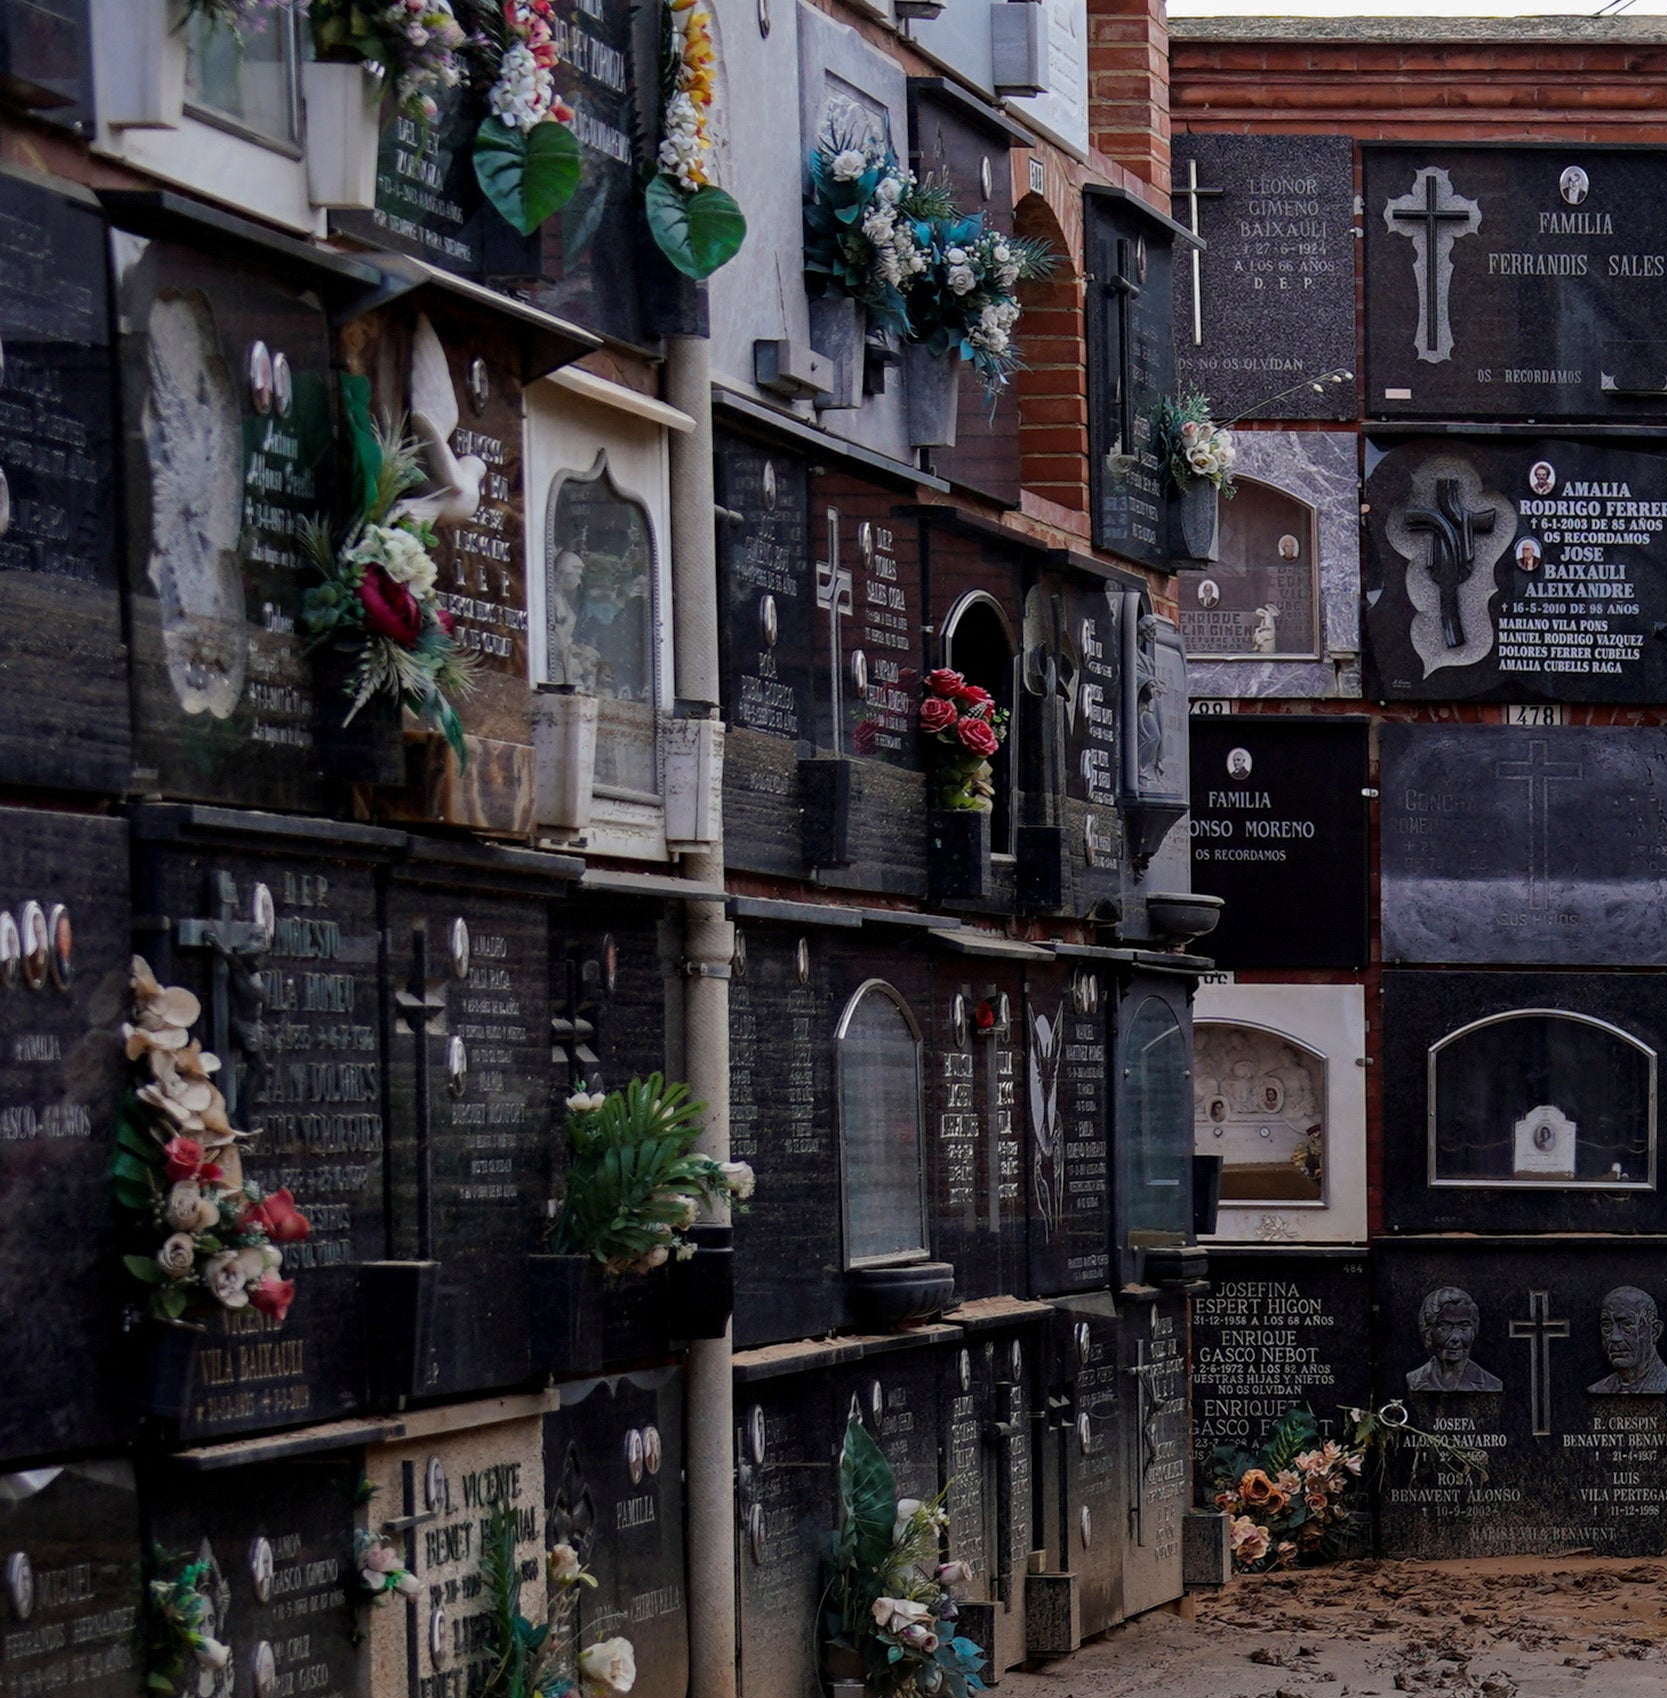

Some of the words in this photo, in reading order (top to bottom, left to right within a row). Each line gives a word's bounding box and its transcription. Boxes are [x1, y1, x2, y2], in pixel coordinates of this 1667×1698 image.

[1250, 177, 1318, 196] LEONOR
[1248, 199, 1319, 217] GIMENO
[1240, 220, 1327, 239] BAIXAULI
[1539, 212, 1614, 235] FAMILIA
[1487, 252, 1588, 276] FERRANDIS
[1608, 254, 1665, 277] SALES
[1477, 368, 1492, 383] OS
[1504, 369, 1582, 384] RECORDAMOS
[1561, 481, 1632, 498] AMALIA
[1519, 499, 1601, 517] RODRIGO
[1540, 517, 1588, 530] 6-1-2003
[1591, 518, 1609, 530] DE
[1611, 518, 1626, 531] 85
[1543, 531, 1561, 543] OS
[1564, 532, 1651, 545] RECORDAMOS
[1560, 546, 1604, 562] JOSE
[1544, 564, 1626, 580] BAIXAULI
[1524, 582, 1635, 599] ALEIXANDRE
[1498, 617, 1550, 631] MARIANO
[1551, 619, 1577, 631] VILA
[1579, 619, 1609, 632] PONS
[1498, 631, 1542, 648] MANUEL
[1544, 632, 1594, 645] RODRIGO
[1596, 634, 1644, 648] VAZQUEZ
[1512, 703, 1559, 721] 478
[1208, 791, 1272, 809] FAMILIA
[1245, 820, 1315, 839] MORENO
[1215, 1281, 1300, 1298] JOSEFINA
[1195, 1298, 1262, 1315] ESPERT
[1221, 1330, 1297, 1346] ENRIQUE
[1199, 1347, 1256, 1363] GASCO
[1261, 1346, 1319, 1363] NEBOT
[1562, 1433, 1624, 1447] BENAVENT
[1613, 1471, 1641, 1485] LUIS
[1580, 1488, 1610, 1502] VILA
